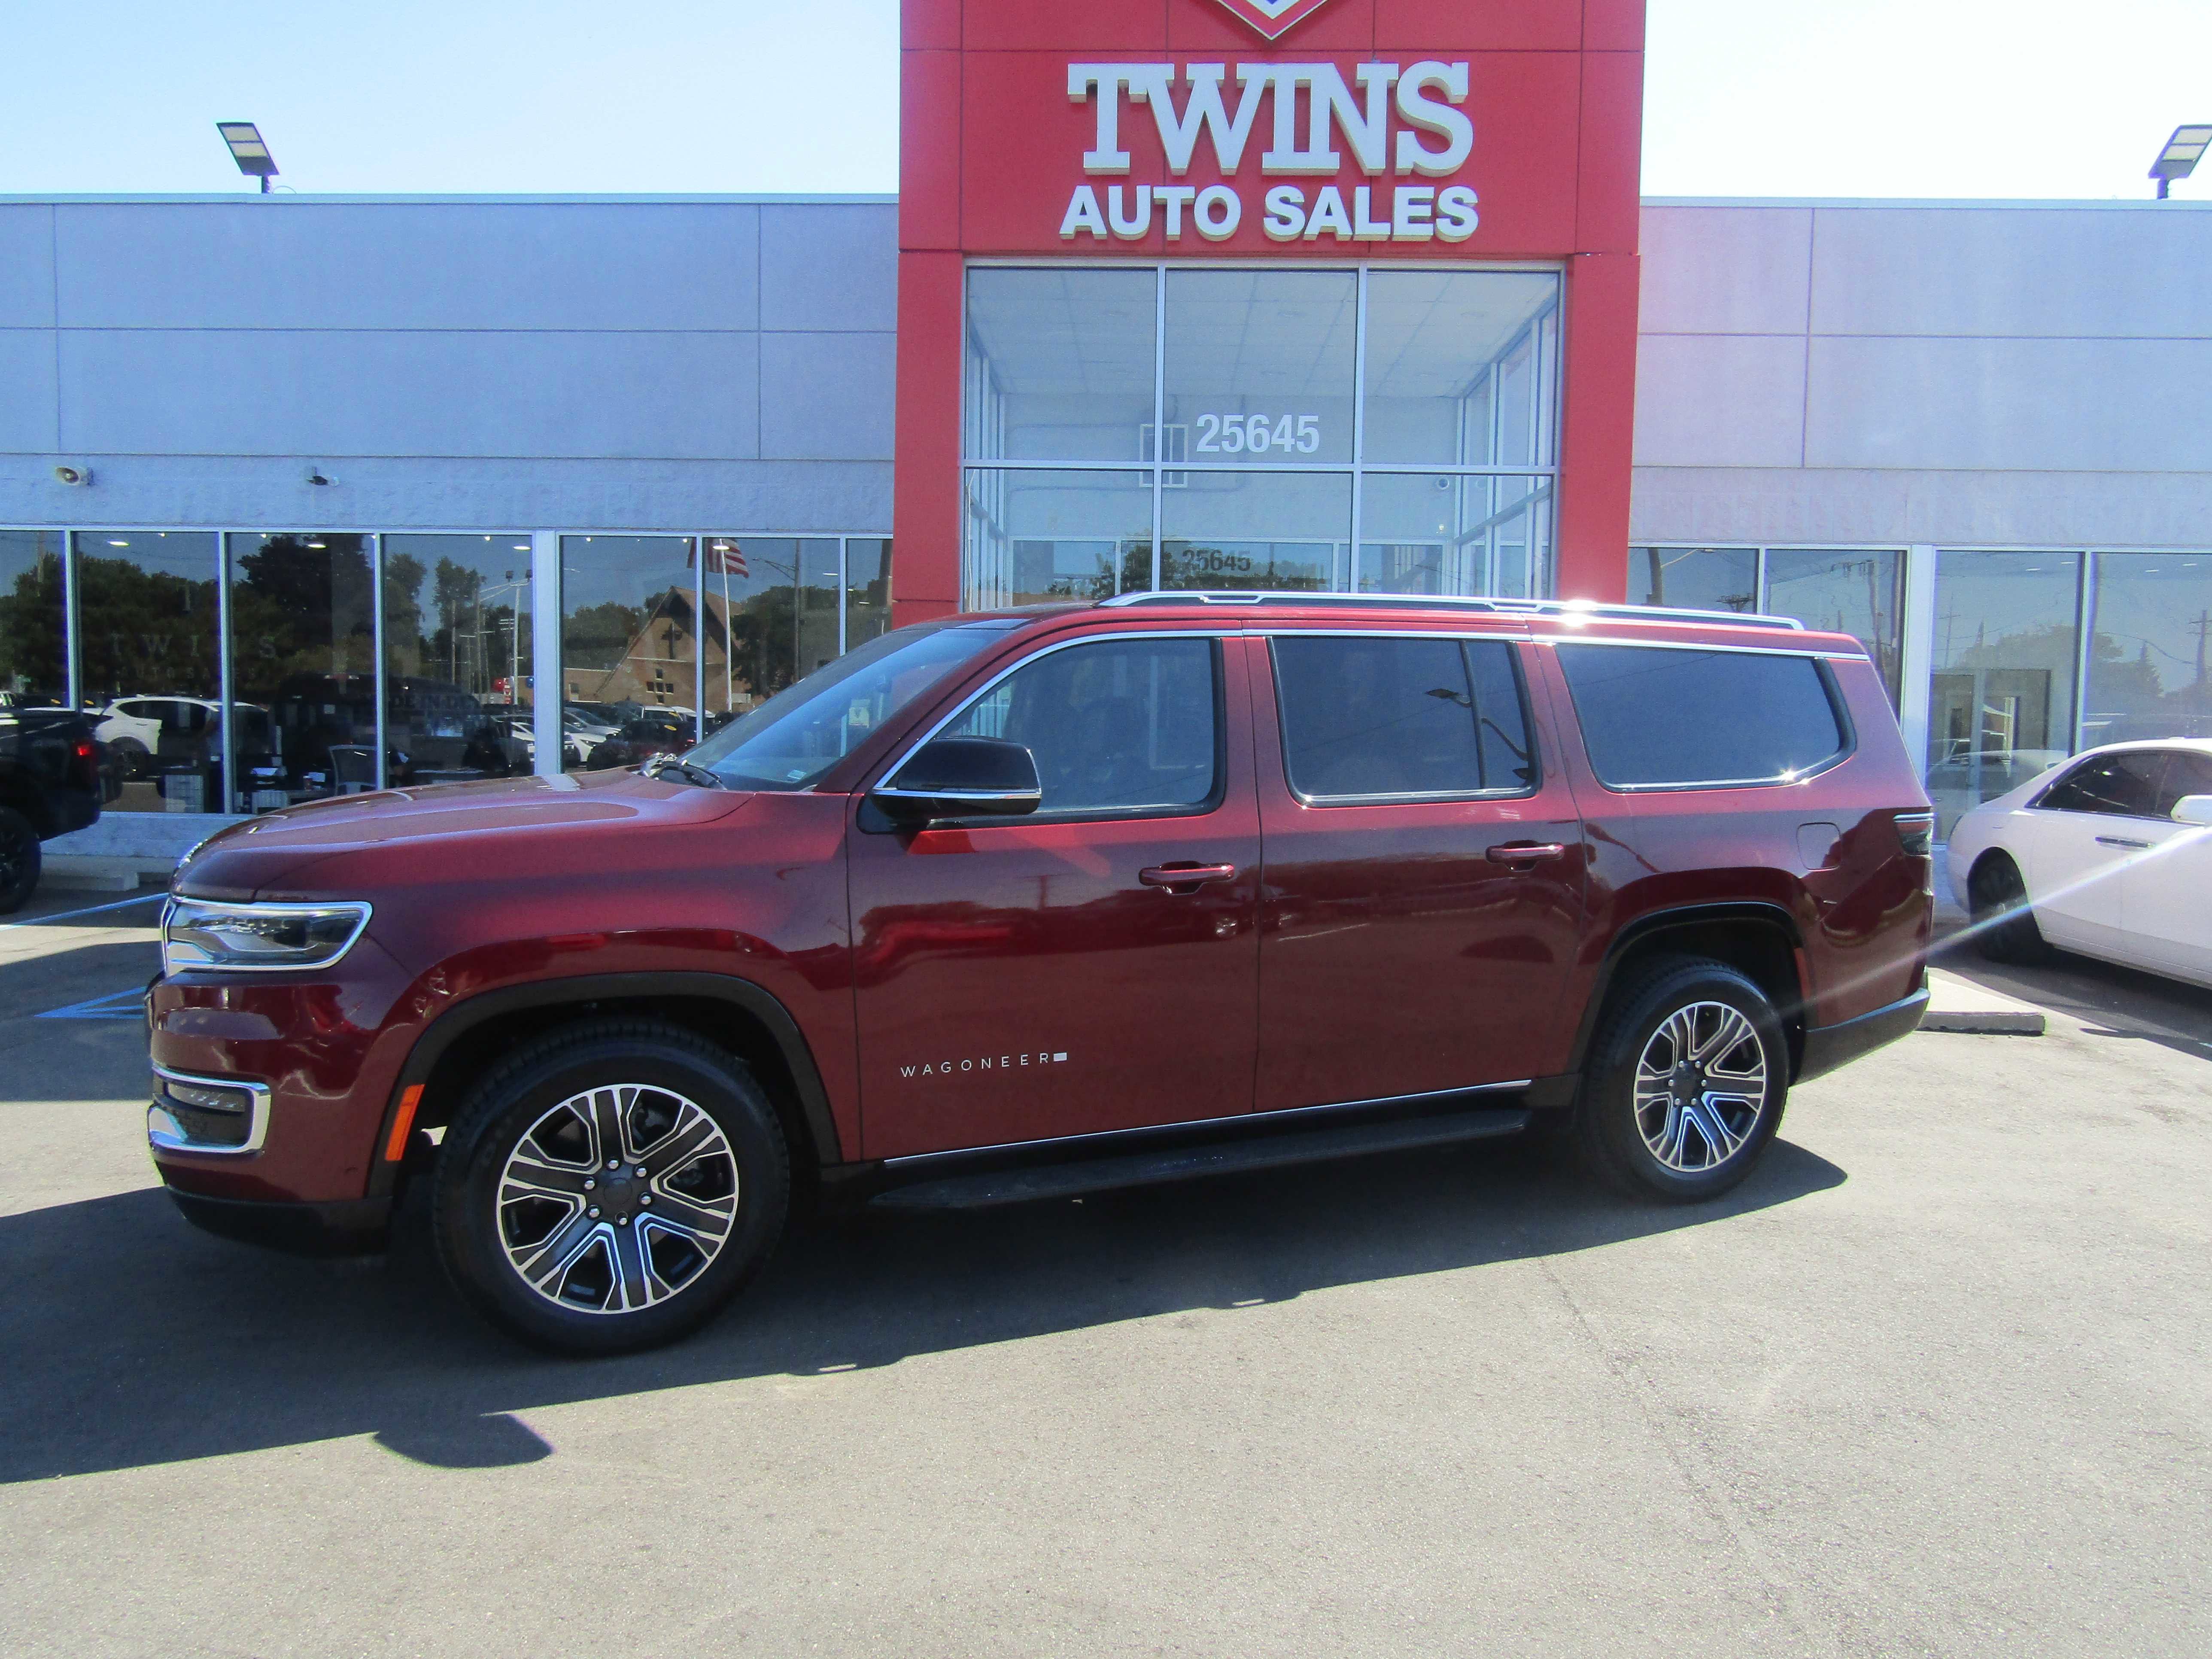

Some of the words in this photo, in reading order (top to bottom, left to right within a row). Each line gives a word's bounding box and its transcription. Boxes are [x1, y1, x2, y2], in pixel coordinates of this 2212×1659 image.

[1068, 61, 1474, 177] TWINS
[1059, 185, 1242, 241] AUTO
[1263, 185, 1480, 242] SALES
[1196, 414, 1320, 453] 25645
[900, 1053, 1048, 1077] WAGONEER
